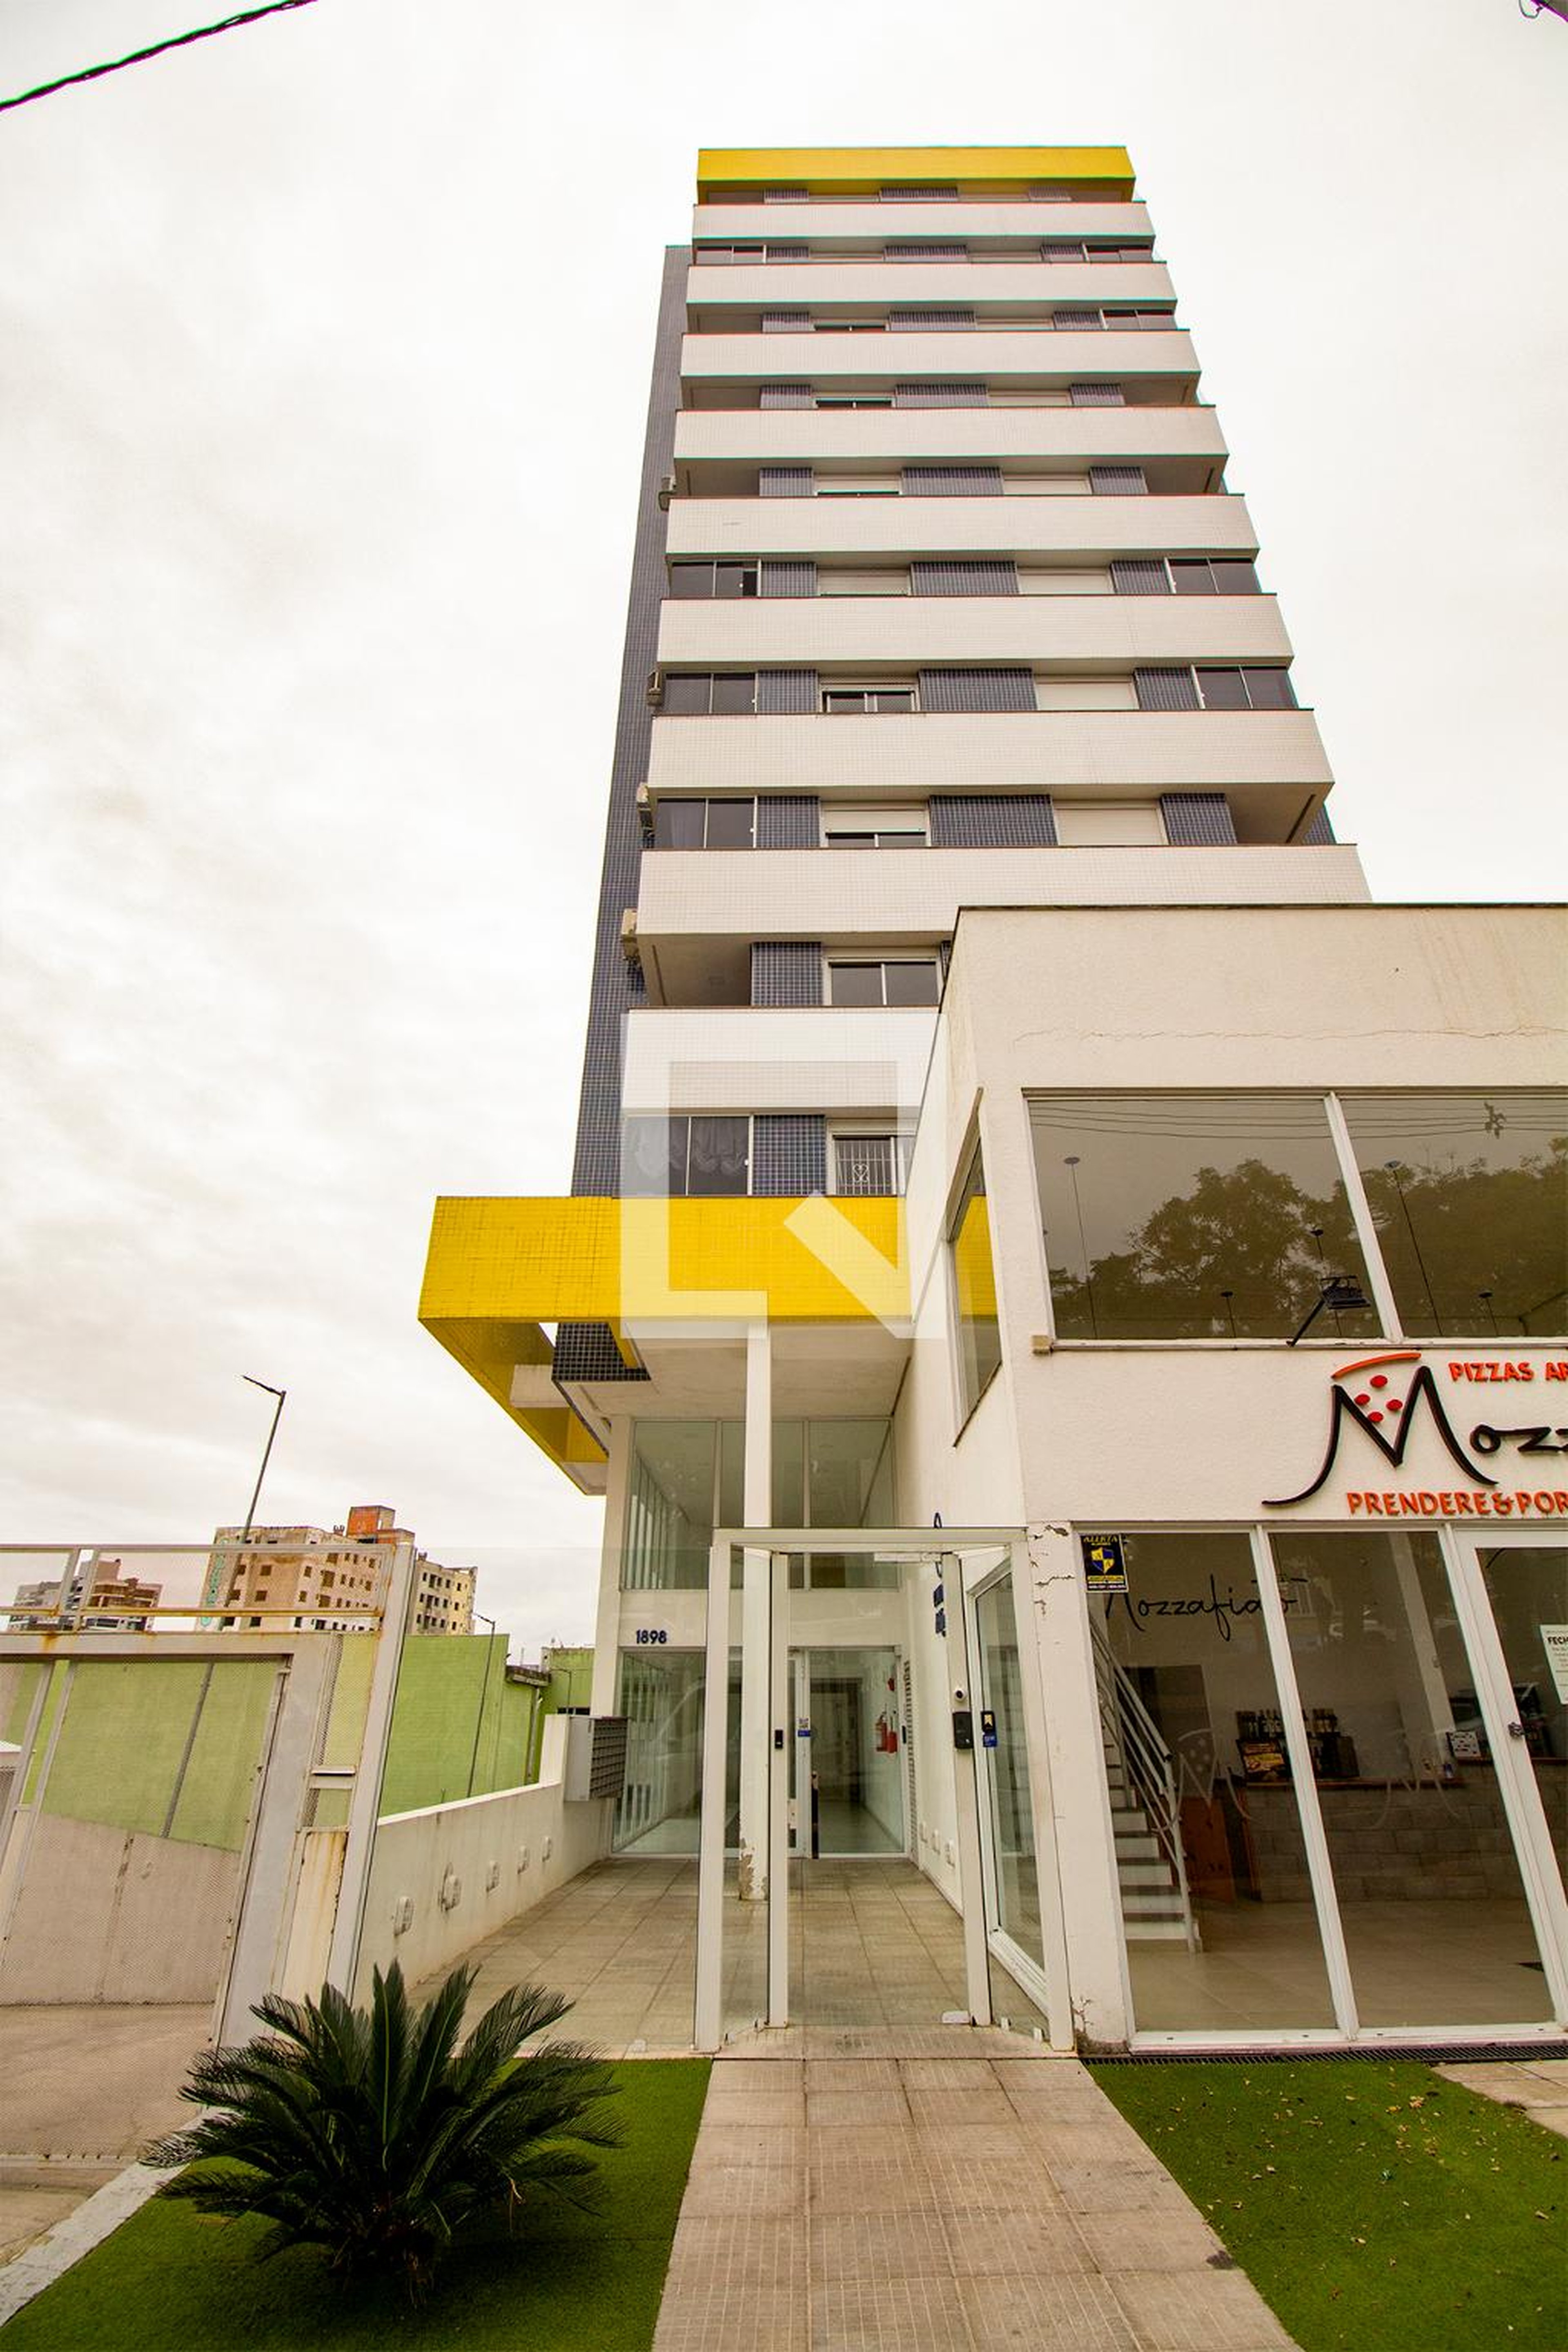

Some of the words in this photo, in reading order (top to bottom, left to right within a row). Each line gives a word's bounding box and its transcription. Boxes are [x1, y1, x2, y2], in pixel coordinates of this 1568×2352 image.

[1448, 1362, 1534, 1381] PIZZAS
[1105, 1574, 1308, 1642] ozzafiao
[637, 1629, 667, 1644] 1898
